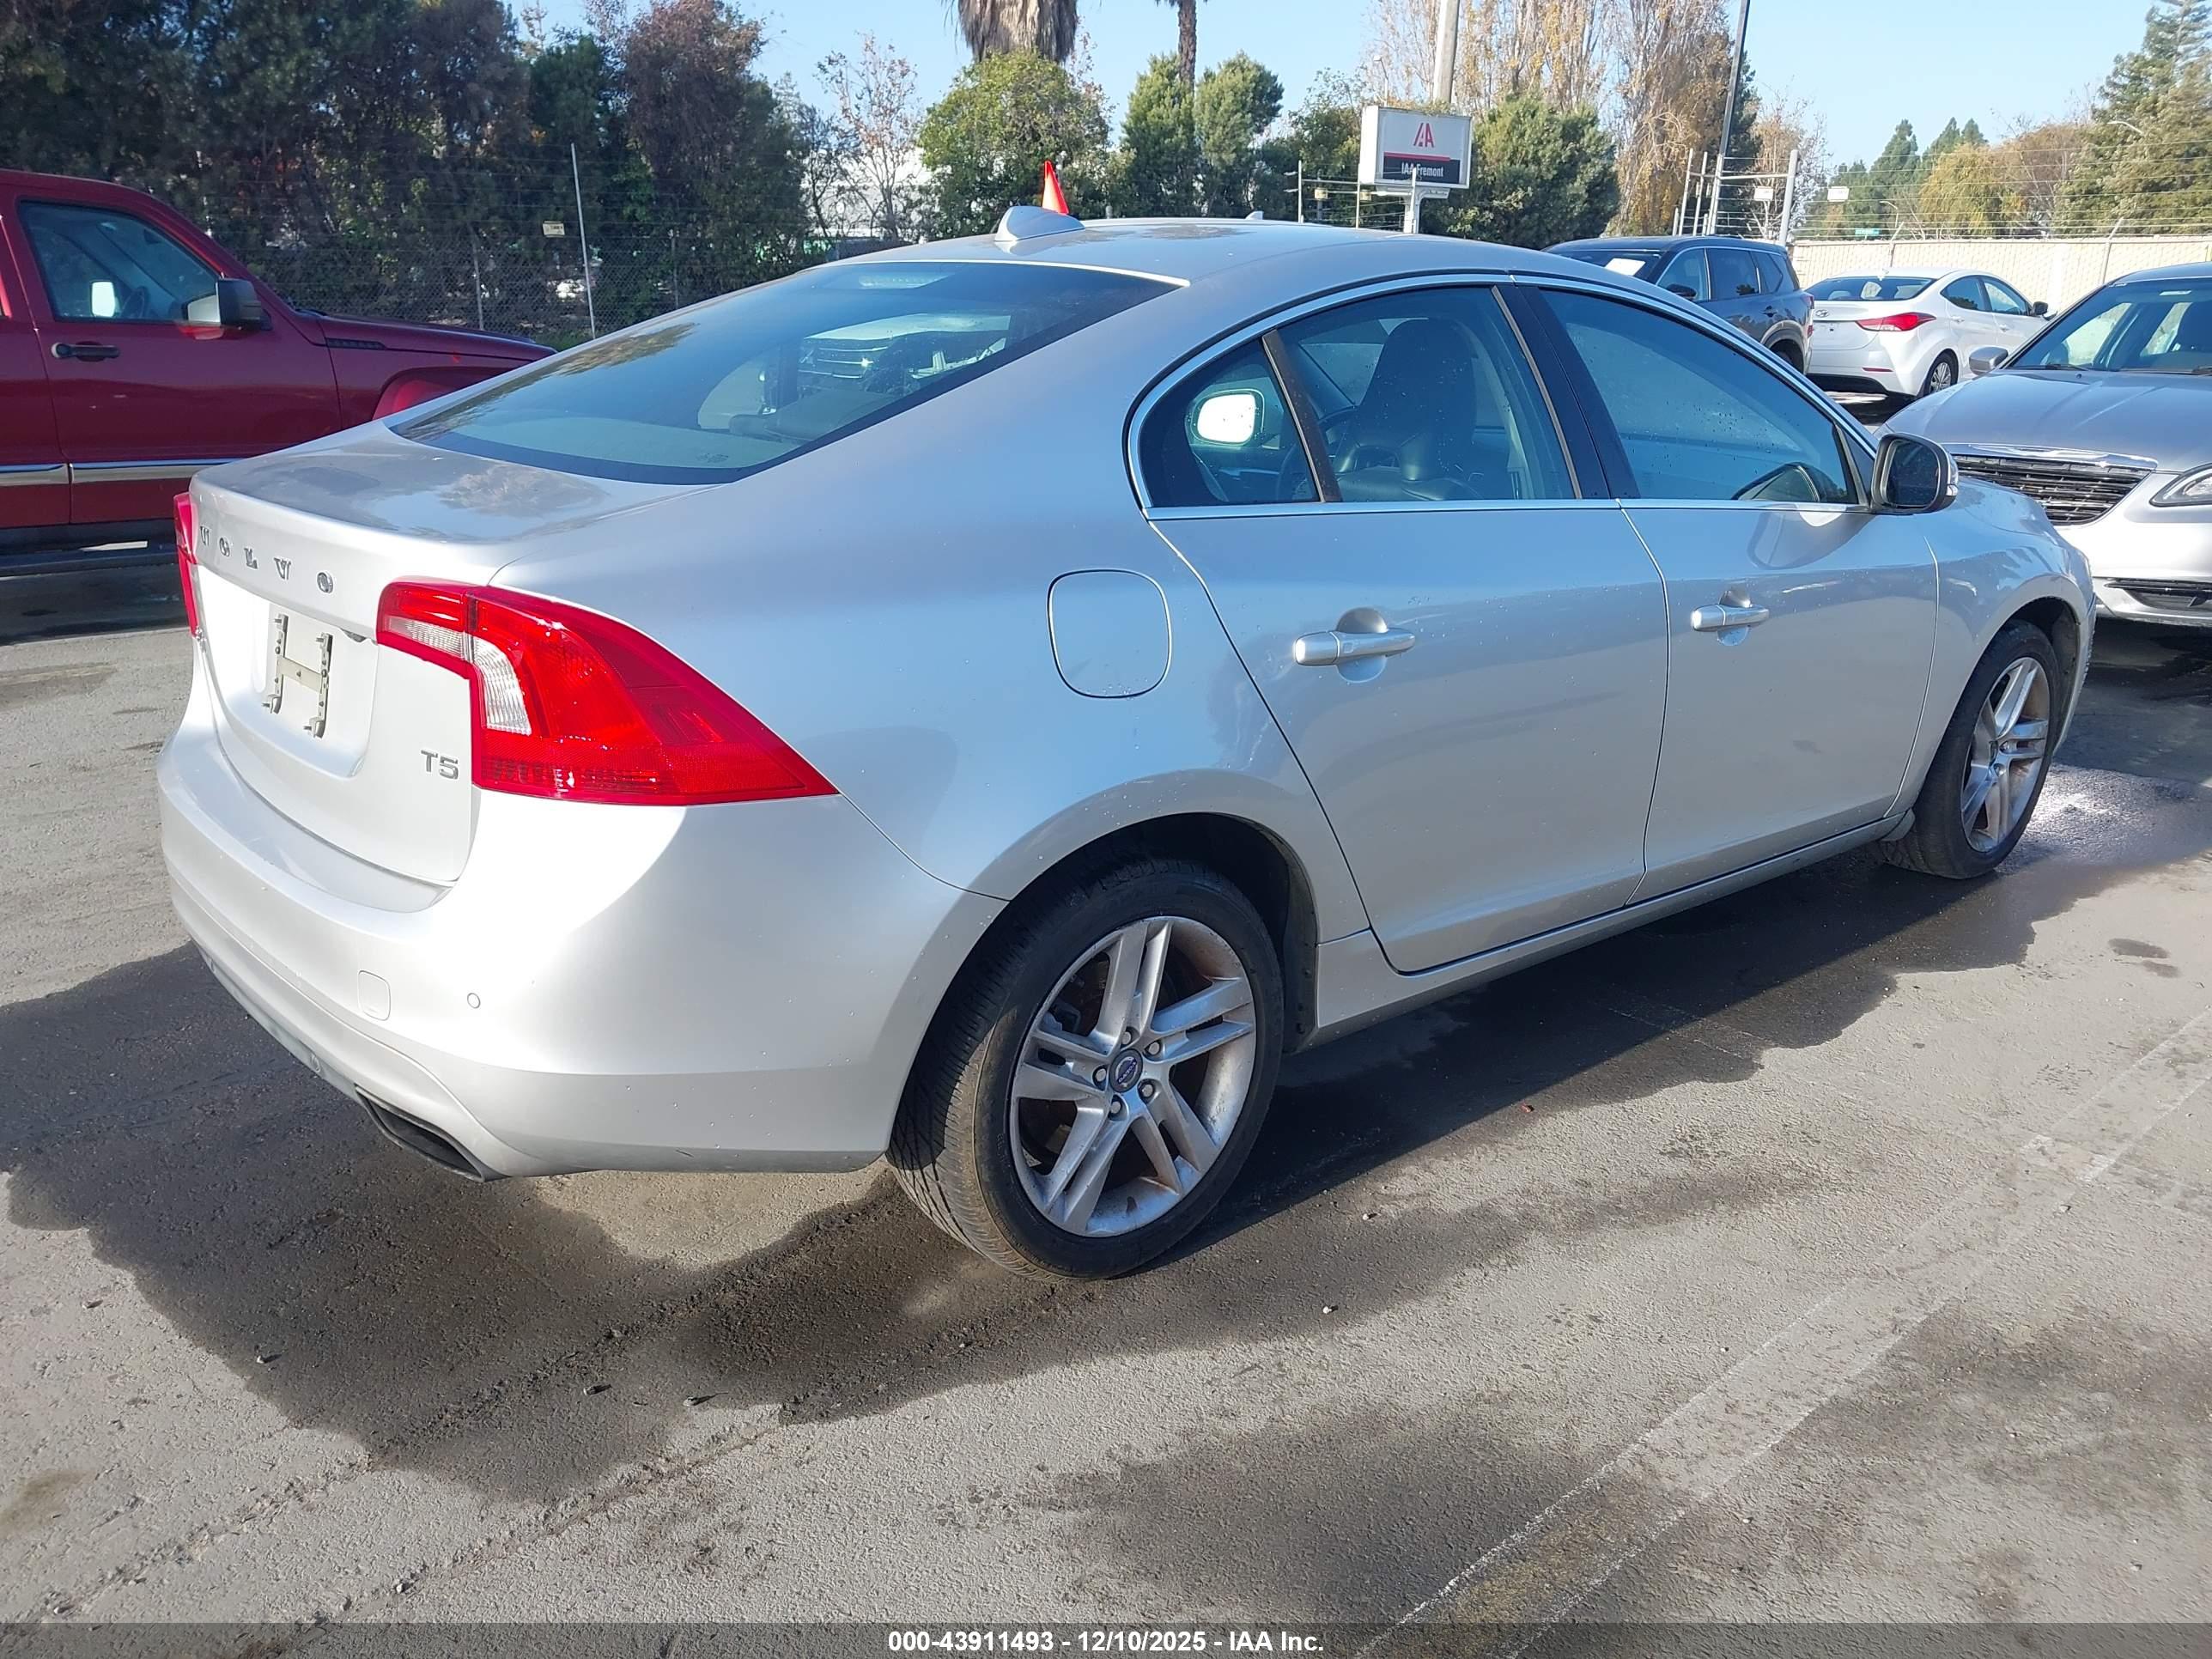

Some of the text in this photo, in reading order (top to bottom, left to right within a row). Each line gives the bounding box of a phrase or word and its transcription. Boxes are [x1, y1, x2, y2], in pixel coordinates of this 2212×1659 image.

[1416, 163, 1443, 177] Fremont
[199, 526, 334, 594] VOLVO
[420, 750, 459, 780] T5
